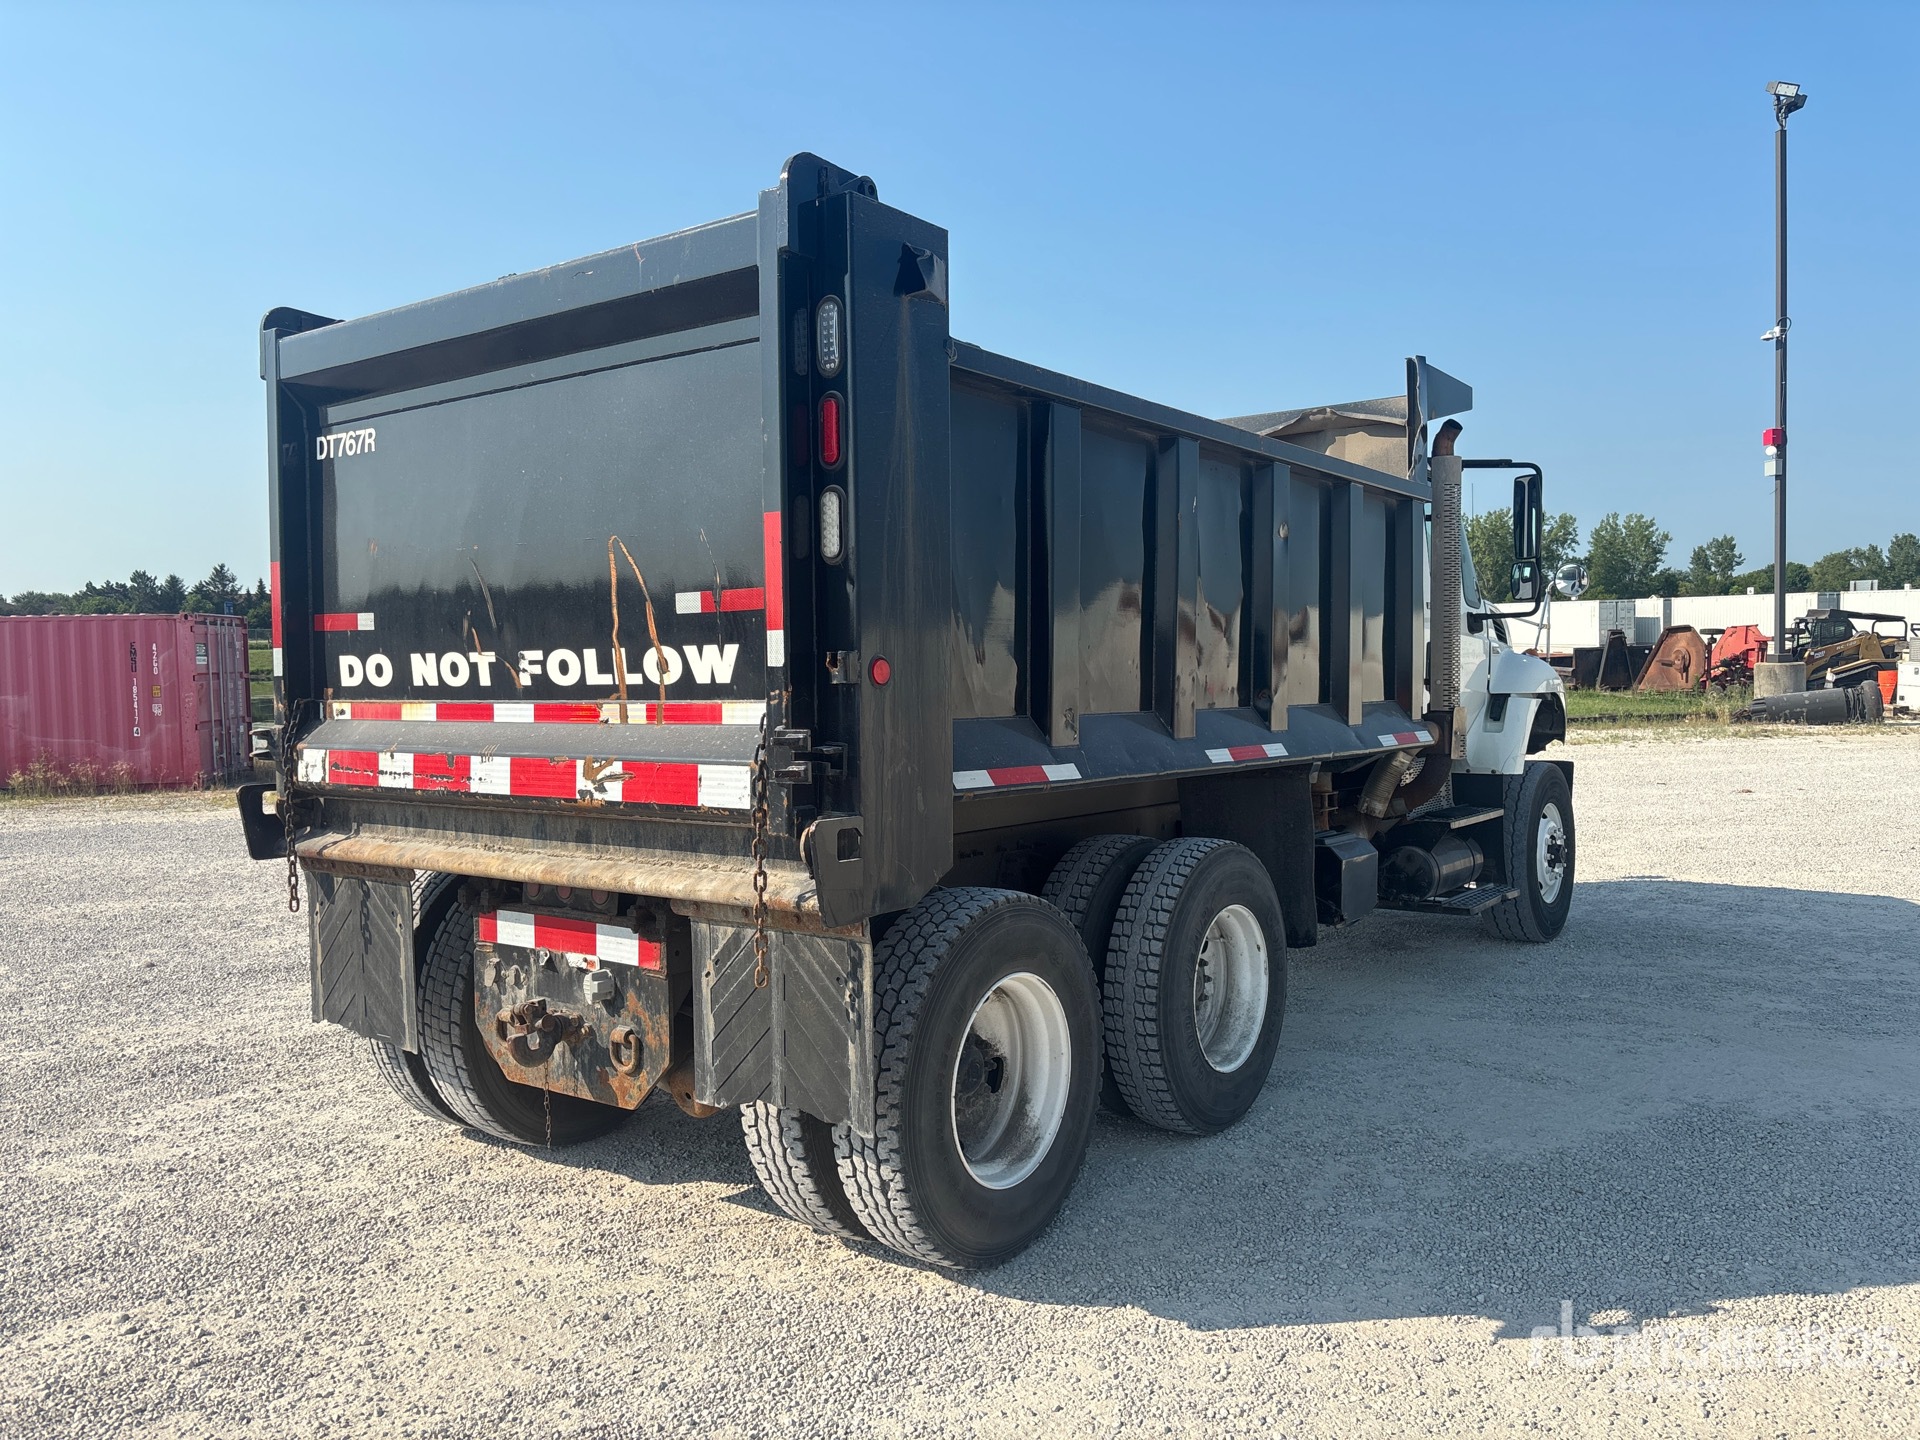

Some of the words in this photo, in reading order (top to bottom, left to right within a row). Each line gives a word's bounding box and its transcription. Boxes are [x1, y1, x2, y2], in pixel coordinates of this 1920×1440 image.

[316, 427, 376, 461] DT767R
[338, 653, 393, 687] DO
[410, 651, 496, 687] NOT
[518, 643, 740, 686] FOLLOW
